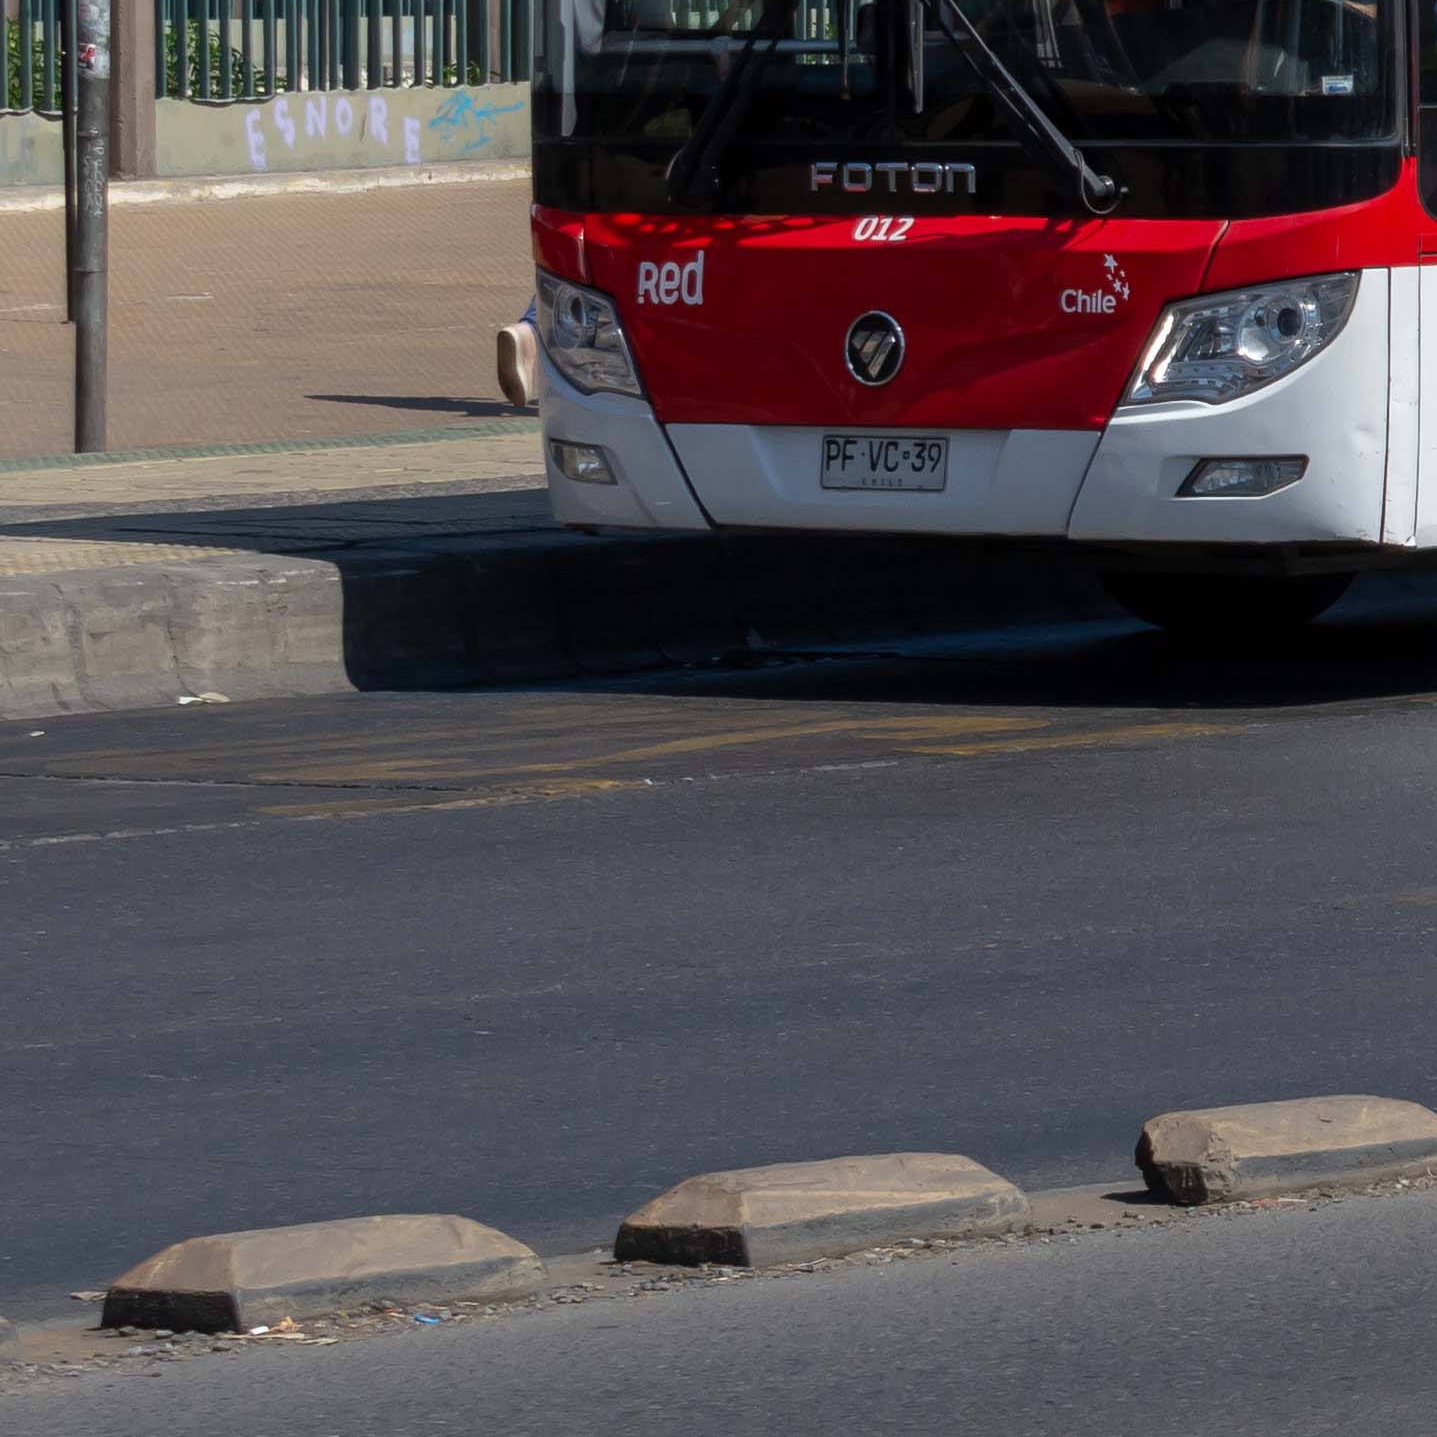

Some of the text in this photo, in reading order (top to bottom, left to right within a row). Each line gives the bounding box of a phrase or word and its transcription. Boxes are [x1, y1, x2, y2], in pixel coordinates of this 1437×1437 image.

[811, 163, 976, 193] FOTON
[853, 216, 915, 241] 012
[637, 249, 704, 305] Red
[1060, 289, 1117, 314] Chile
